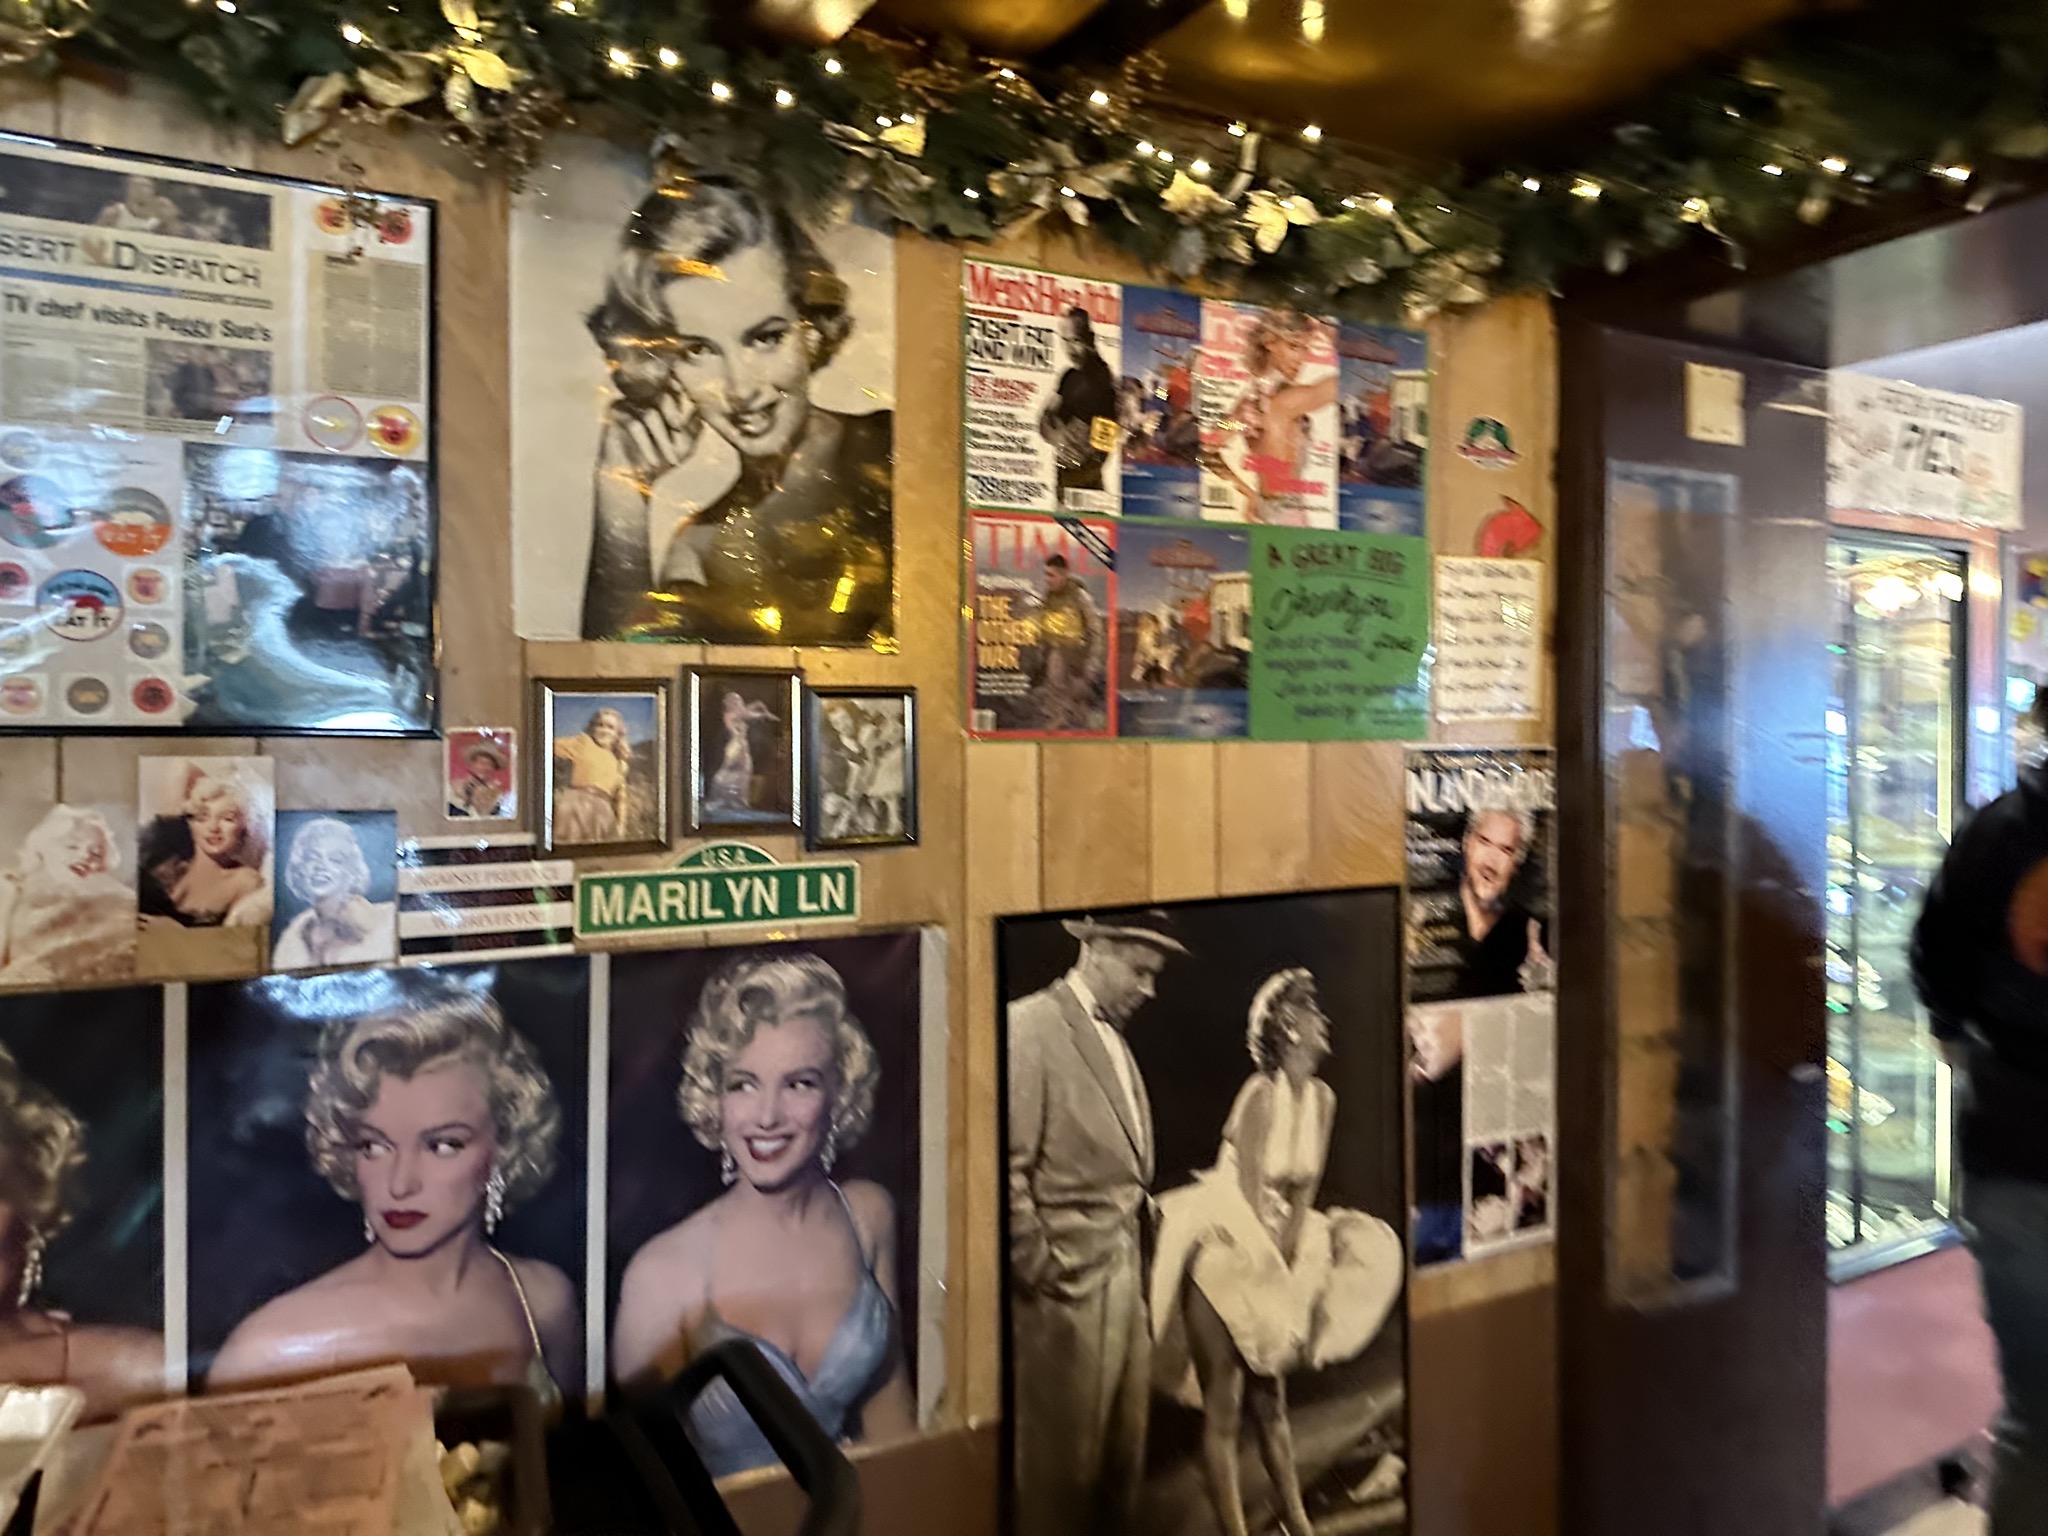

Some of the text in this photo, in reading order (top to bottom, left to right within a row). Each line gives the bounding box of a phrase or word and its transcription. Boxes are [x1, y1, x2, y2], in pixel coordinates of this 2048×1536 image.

[4, 292, 28, 315] TV
[35, 298, 86, 321] chef
[91, 306, 149, 329] visits
[155, 311, 214, 340] Peggy
[701, 848, 750, 869] USA
[590, 875, 780, 926] MARILYN
[797, 872, 848, 913] LN
